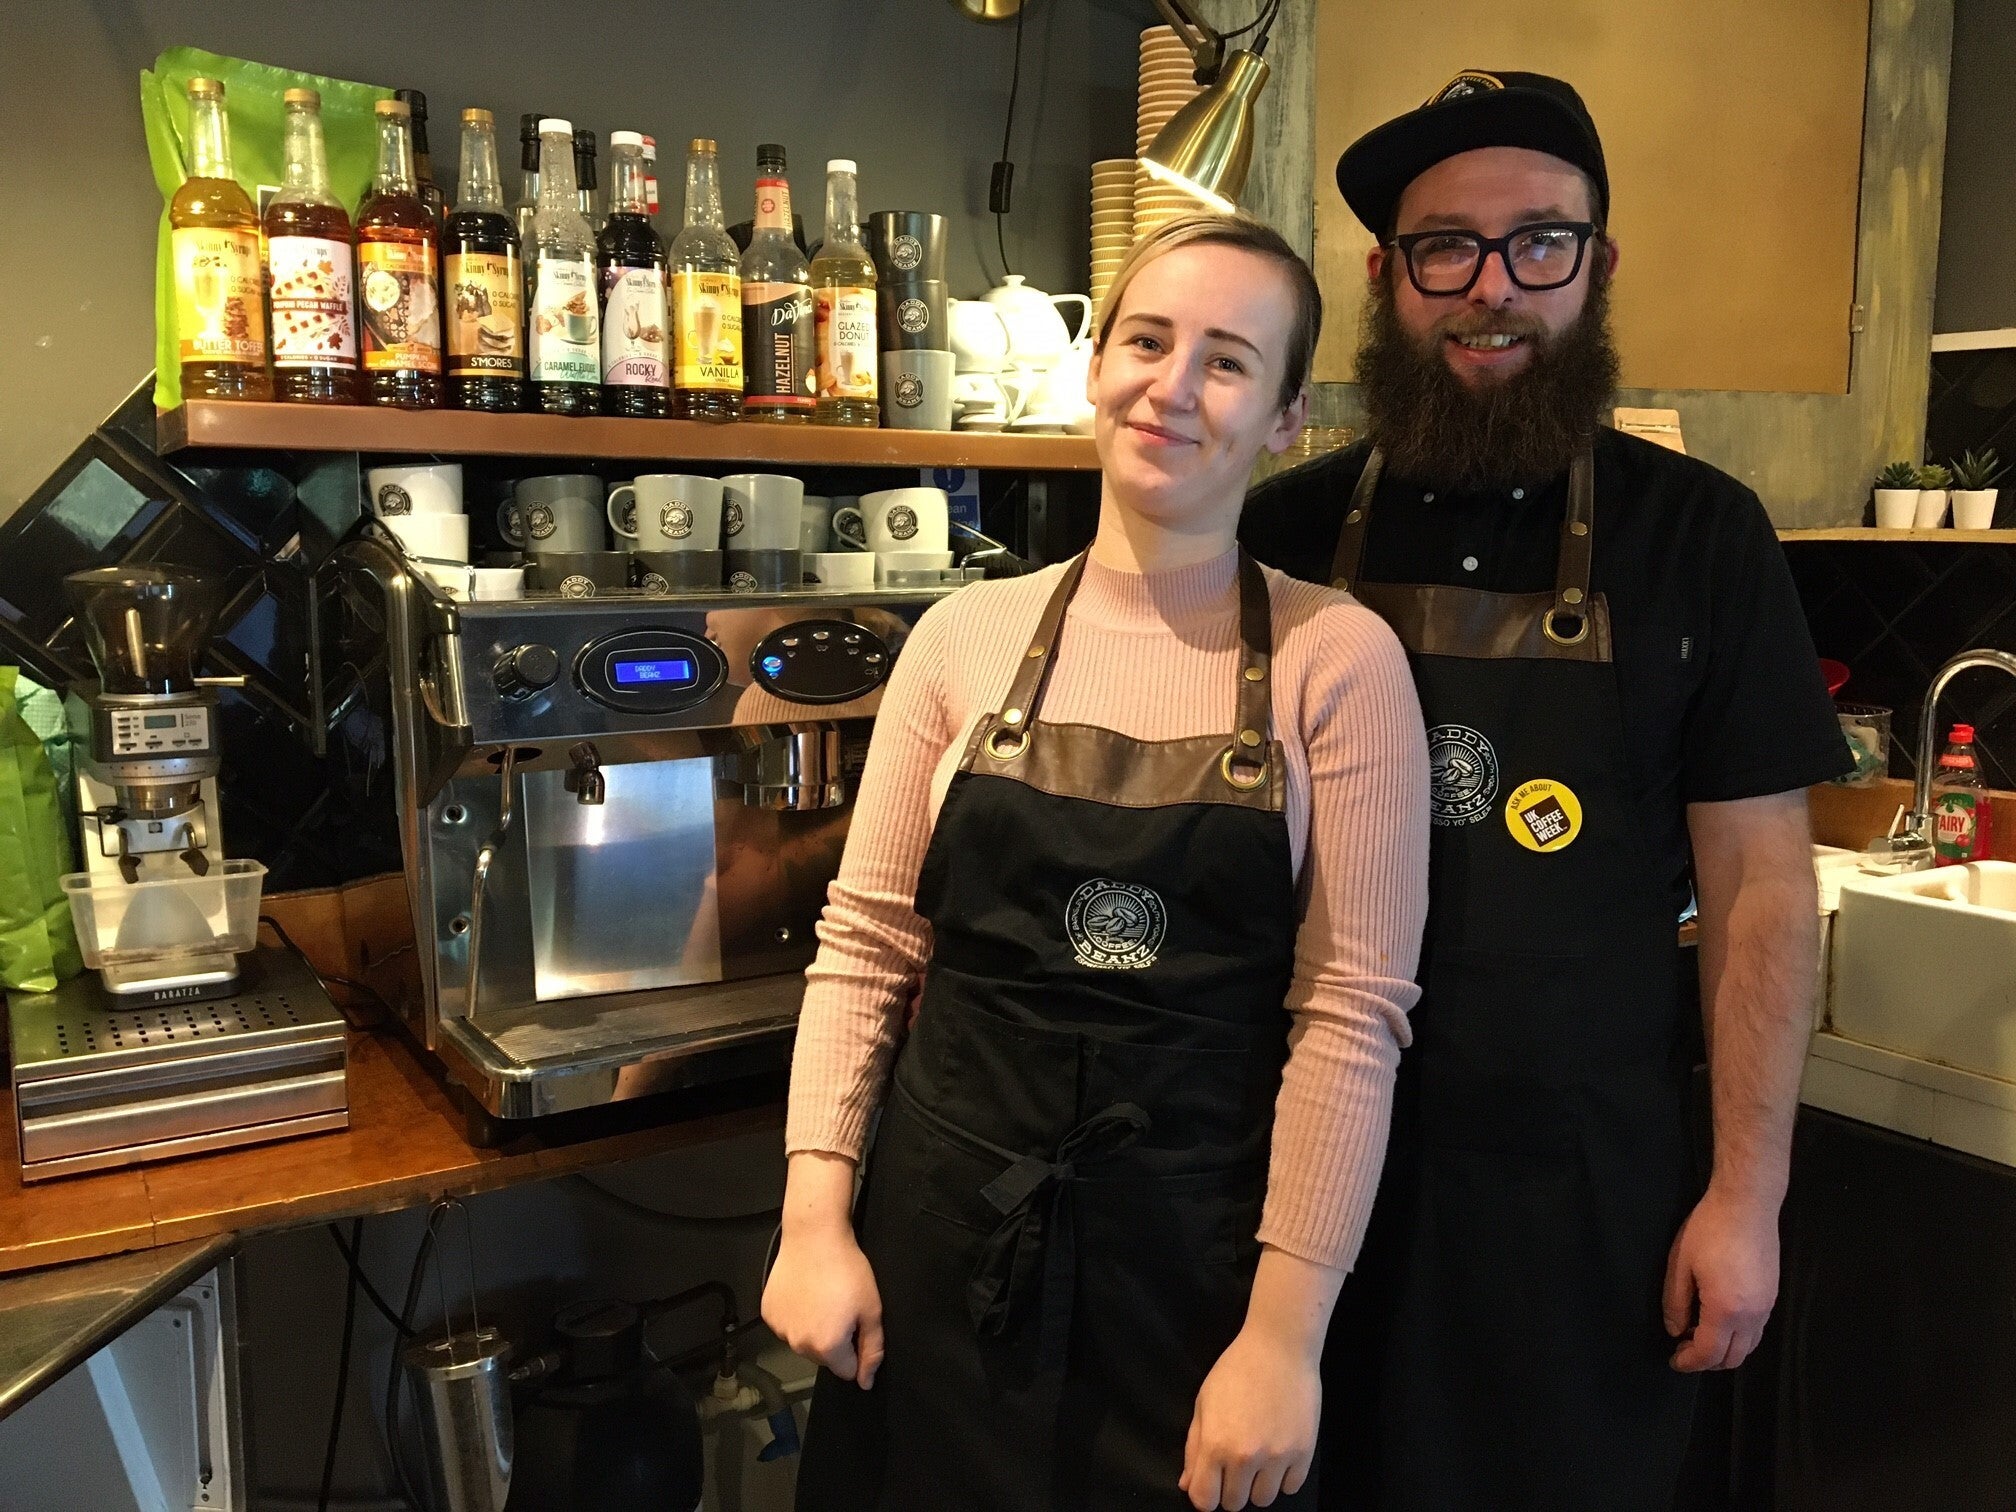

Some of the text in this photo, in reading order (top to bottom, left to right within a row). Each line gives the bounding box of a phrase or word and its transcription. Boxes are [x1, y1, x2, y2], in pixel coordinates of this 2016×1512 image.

[320, 302, 343, 312] WAFFLE
[838, 321, 870, 332] GLAZED
[839, 331, 869, 341] DONUT
[544, 362, 577, 371] CARAMEL
[625, 363, 656, 376] ROCKY
[775, 333, 791, 393] HAZELNUT
[700, 367, 739, 379] VANILLA
[663, 501, 690, 511] DADDY
[562, 577, 589, 592] DADDY
[1431, 729, 1489, 753] ADDY
[1511, 783, 1552, 810] ASK ME ABOUT
[1431, 794, 1485, 815] EANZ
[1524, 809, 1540, 824] UK
[1530, 808, 1564, 833] COFFEE
[1938, 814, 1965, 833] AIRY
[1536, 822, 1564, 842] WEEK
[1080, 880, 1155, 901] DADDY
[1094, 935, 1137, 950] COFFEE
[1079, 940, 1150, 965] BEANZ
